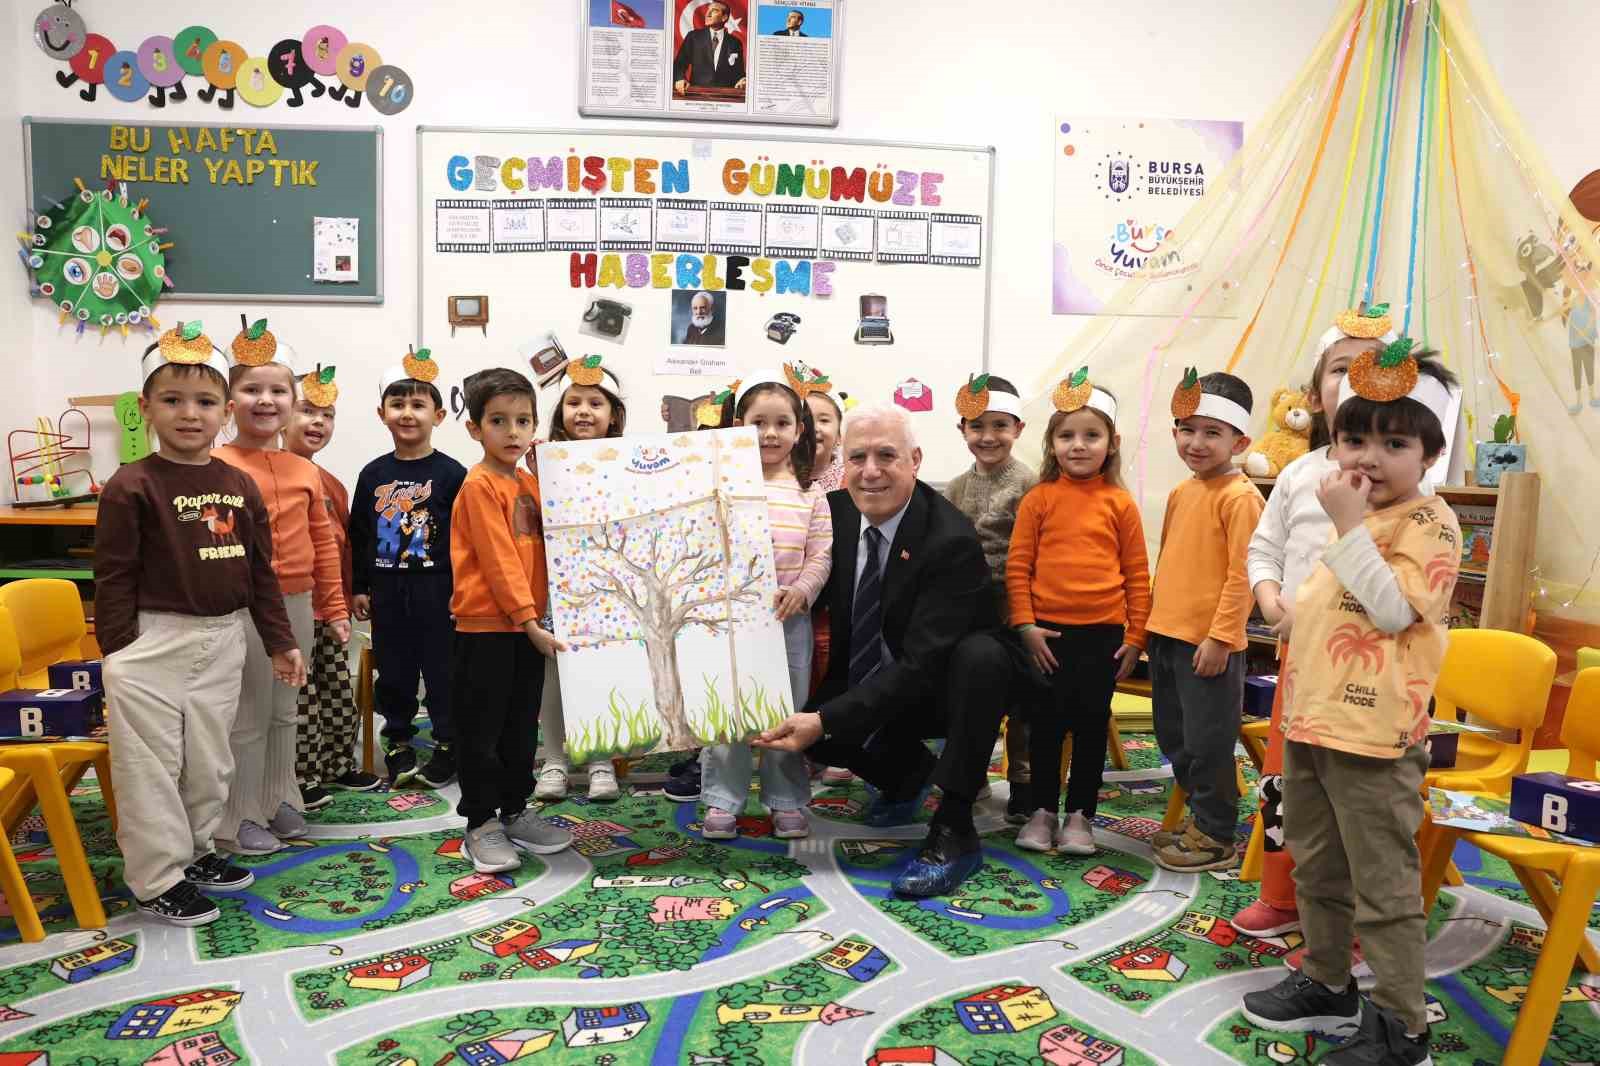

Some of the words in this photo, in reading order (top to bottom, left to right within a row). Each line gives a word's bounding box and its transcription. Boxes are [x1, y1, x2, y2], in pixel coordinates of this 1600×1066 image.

[88, 49, 99, 70] 1
[117, 65, 133, 87] 2
[153, 50, 168, 72] 3
[280, 49, 296, 76] 7
[350, 55, 366, 77] 9
[379, 75, 406, 103] 10
[109, 126, 151, 152] BU
[167, 127, 278, 156] HAFTA
[101, 154, 190, 185] NELER
[203, 157, 320, 187] YAPTIK
[447, 147, 690, 195] GEÇMİŞTEN
[722, 155, 945, 206] GÜNÜMÜZE
[1148, 161, 1204, 175] BURSA
[1148, 184, 1204, 196] BELEDİYESİ
[569, 251, 837, 298] HABERLEŞME
[72, 671, 92, 691] B
[1345, 682, 1378, 696] CHILL
[1343, 693, 1376, 708] MODE
[20, 707, 44, 737] B
[1541, 792, 1569, 833] B
